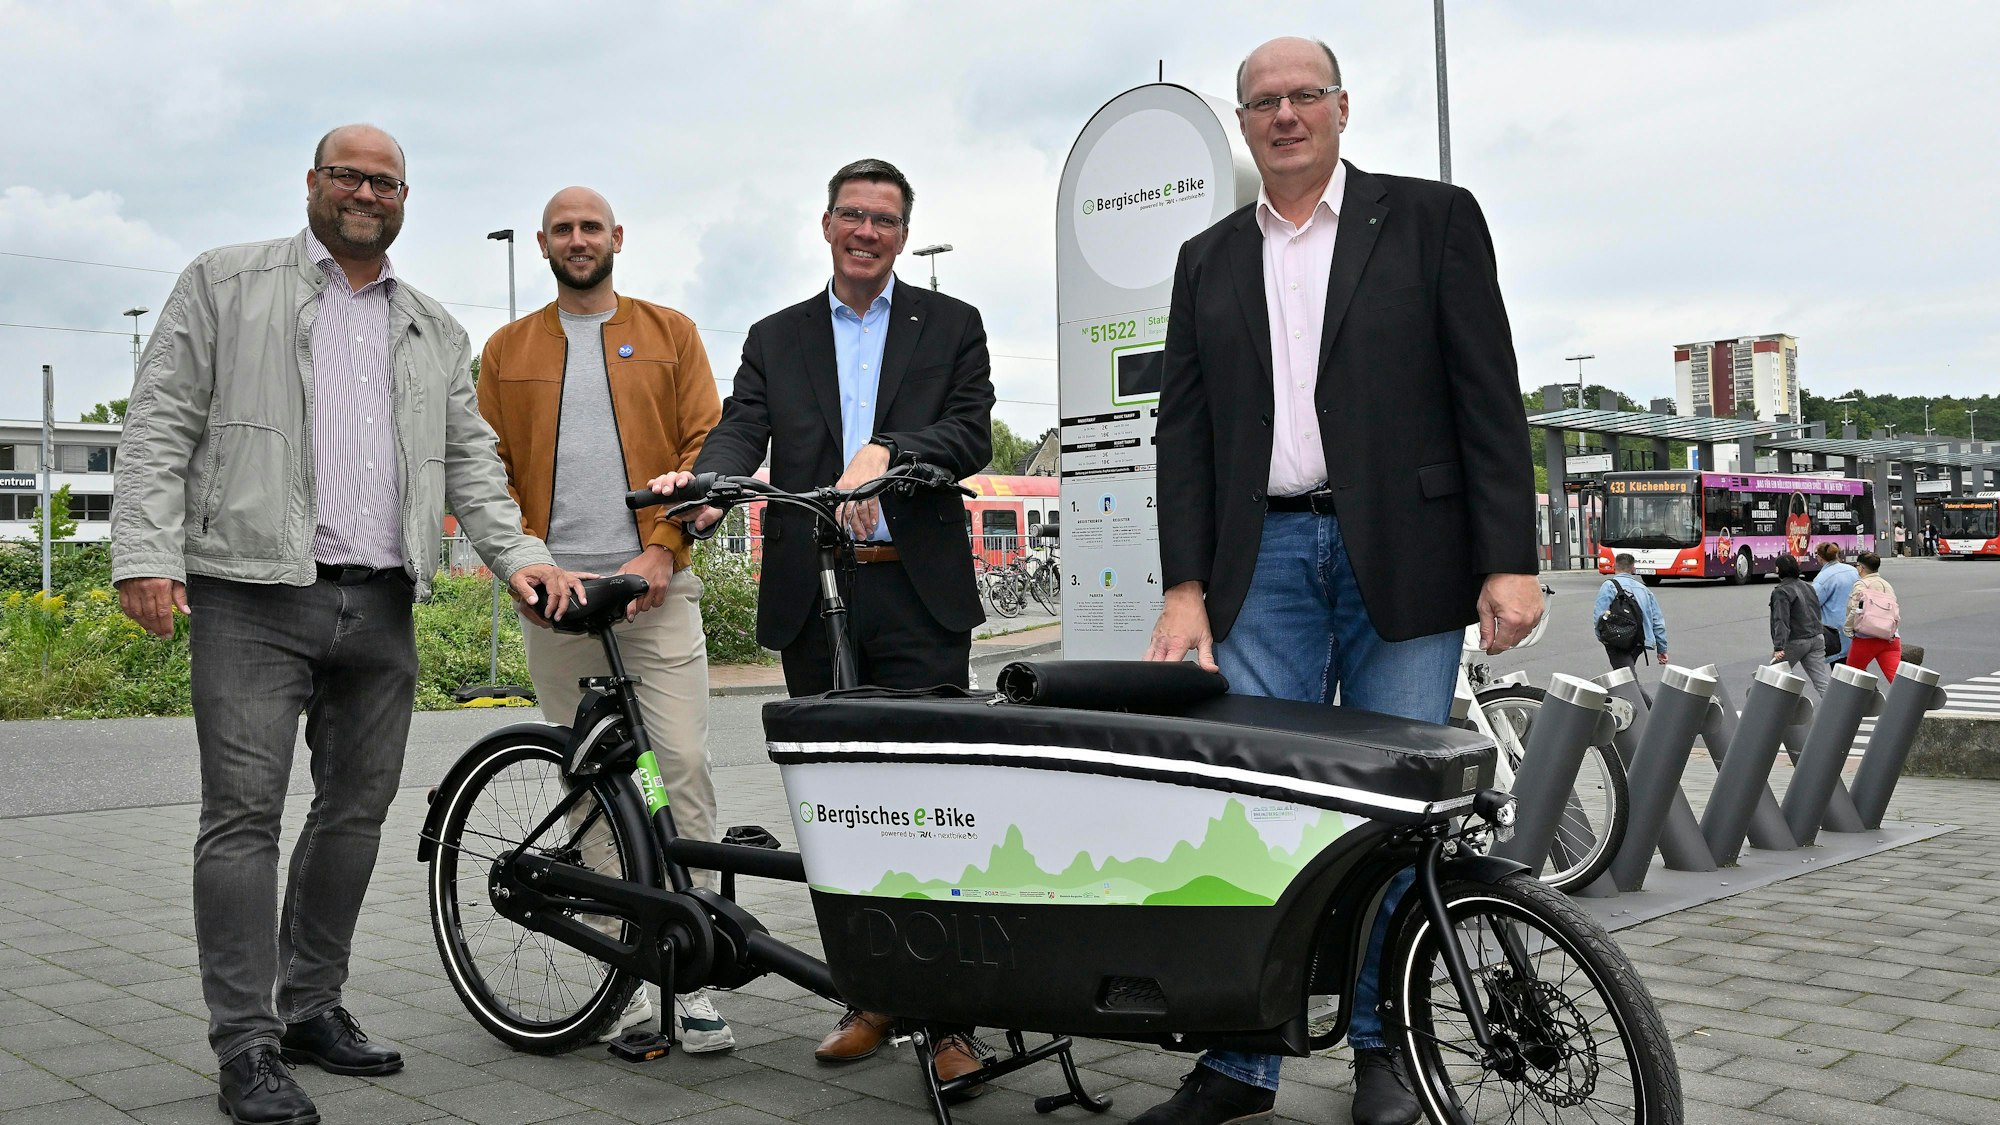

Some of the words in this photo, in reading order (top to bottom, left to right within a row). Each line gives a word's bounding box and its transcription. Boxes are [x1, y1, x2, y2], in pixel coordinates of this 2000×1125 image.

[1097, 188, 1161, 211] Bergisches
[1163, 178, 1204, 197] e-Bike
[1140, 202, 1158, 210] powered
[1091, 320, 1136, 343] 51522
[1610, 481, 1625, 493] 433
[1629, 481, 1687, 493] Küchenberg
[1071, 501, 1080, 512] 1.
[1146, 496, 1156, 508] 2.
[974, 511, 980, 524] 2
[1071, 574, 1081, 586] 3.
[1147, 572, 1158, 584] 4.
[816, 804, 910, 828] Bergisches
[913, 807, 976, 827] e-Bike
[880, 830, 907, 838] powered
[938, 832, 967, 840] nextbike
[864, 908, 1027, 970] DOLLY
